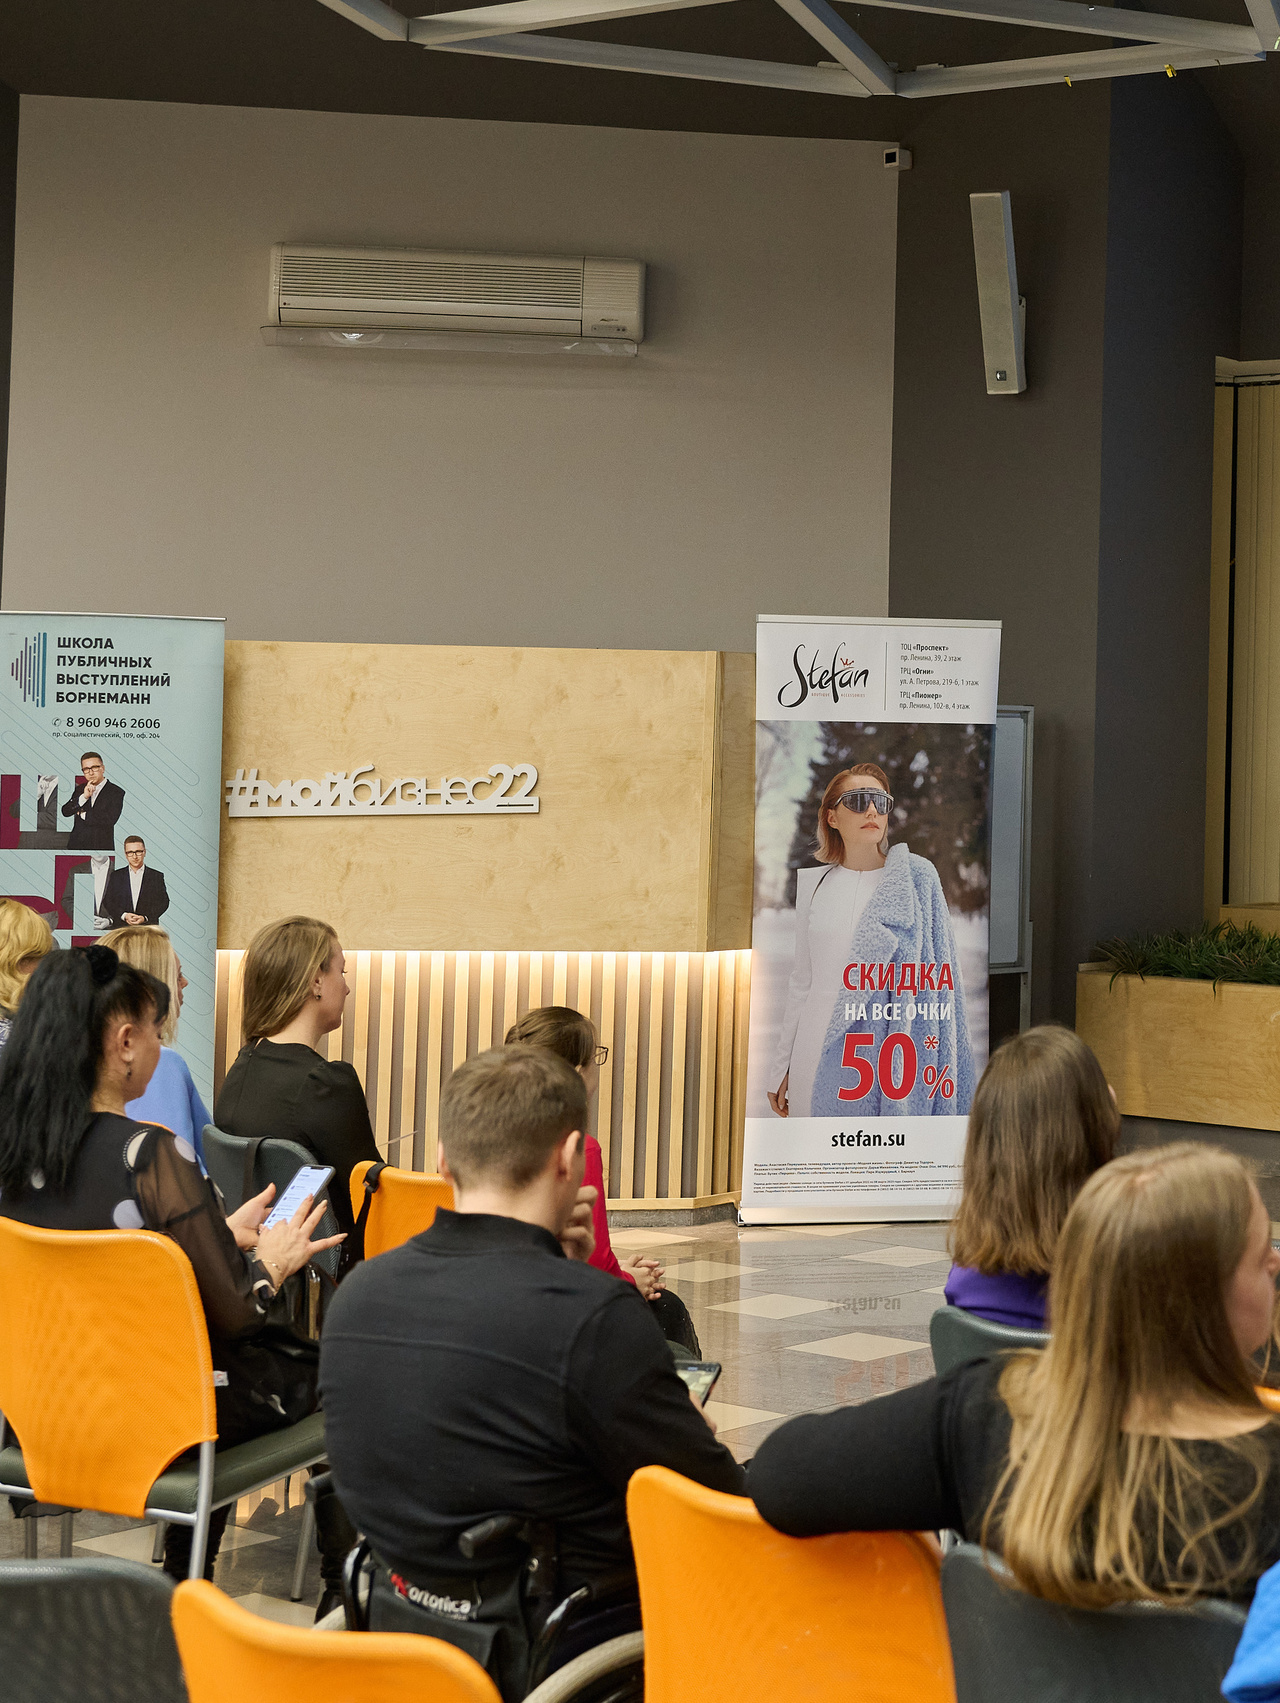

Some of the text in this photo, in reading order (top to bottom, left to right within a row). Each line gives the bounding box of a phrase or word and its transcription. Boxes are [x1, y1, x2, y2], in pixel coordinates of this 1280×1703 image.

[57, 637, 114, 650] ШКОЛА
[56, 655, 152, 669] ПУБЛИЧНЫХ
[56, 673, 171, 687] ВЫСТУПЛЕНИЙ
[777, 641, 870, 709] Stefan
[56, 691, 151, 704] БОРНЕМАНН
[66, 716, 161, 729] 8 960 946 2606
[226, 763, 540, 817] #мойбизнес22
[842, 962, 954, 997] СКИДКА
[844, 1003, 952, 1021] НА ВСЕ ОЧКИ
[831, 1130, 905, 1148] stefan.su
